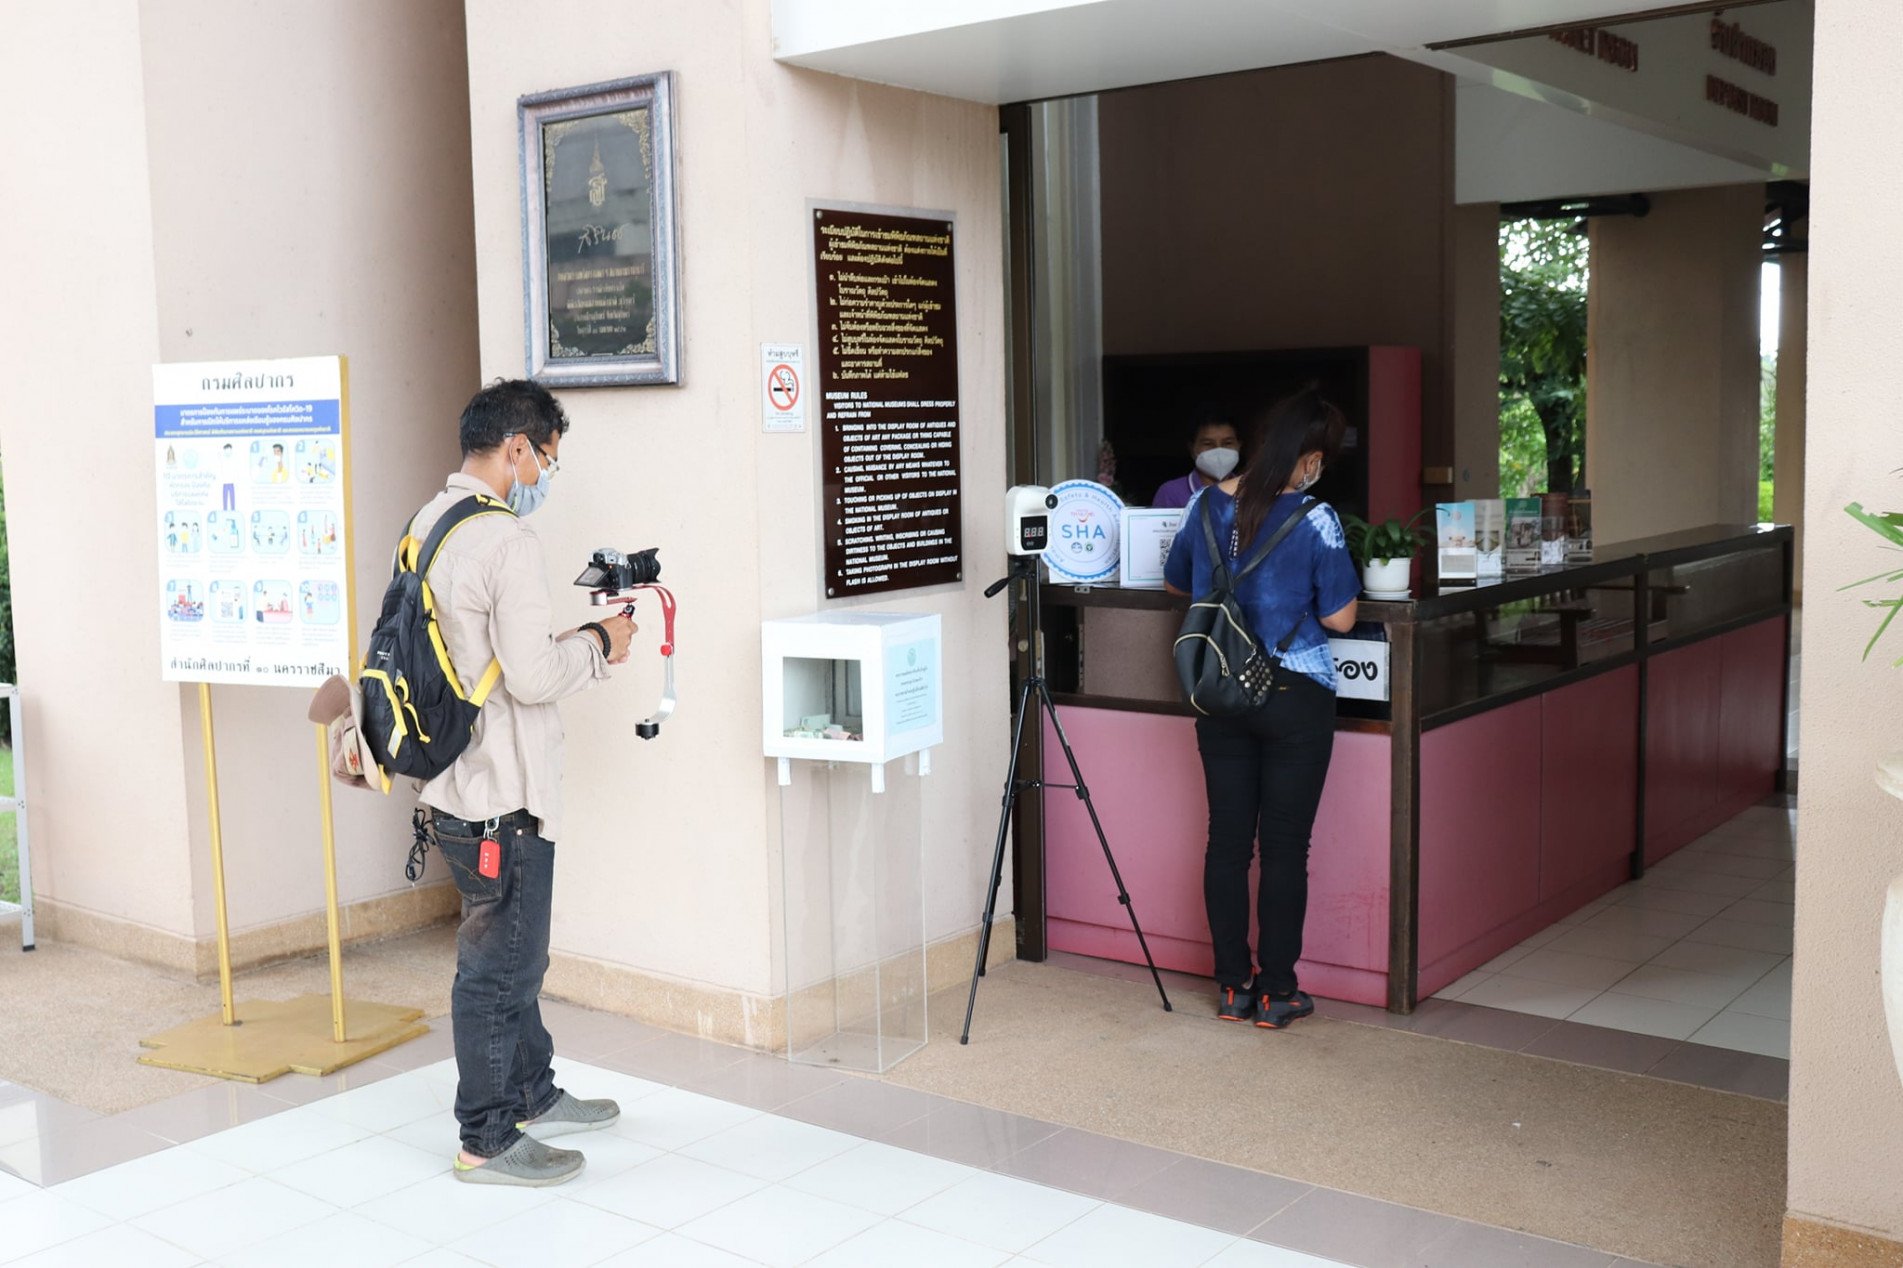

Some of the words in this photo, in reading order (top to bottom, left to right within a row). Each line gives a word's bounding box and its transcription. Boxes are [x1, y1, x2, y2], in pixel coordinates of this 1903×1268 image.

[202, 372, 294, 391] กรมศิลปากร
[1062, 524, 1106, 540] SHA
[171, 656, 250, 672] สำนักศิลปากรที่
[256, 666, 269, 674] ๑๐
[274, 662, 340, 676] นครราชสีมา
